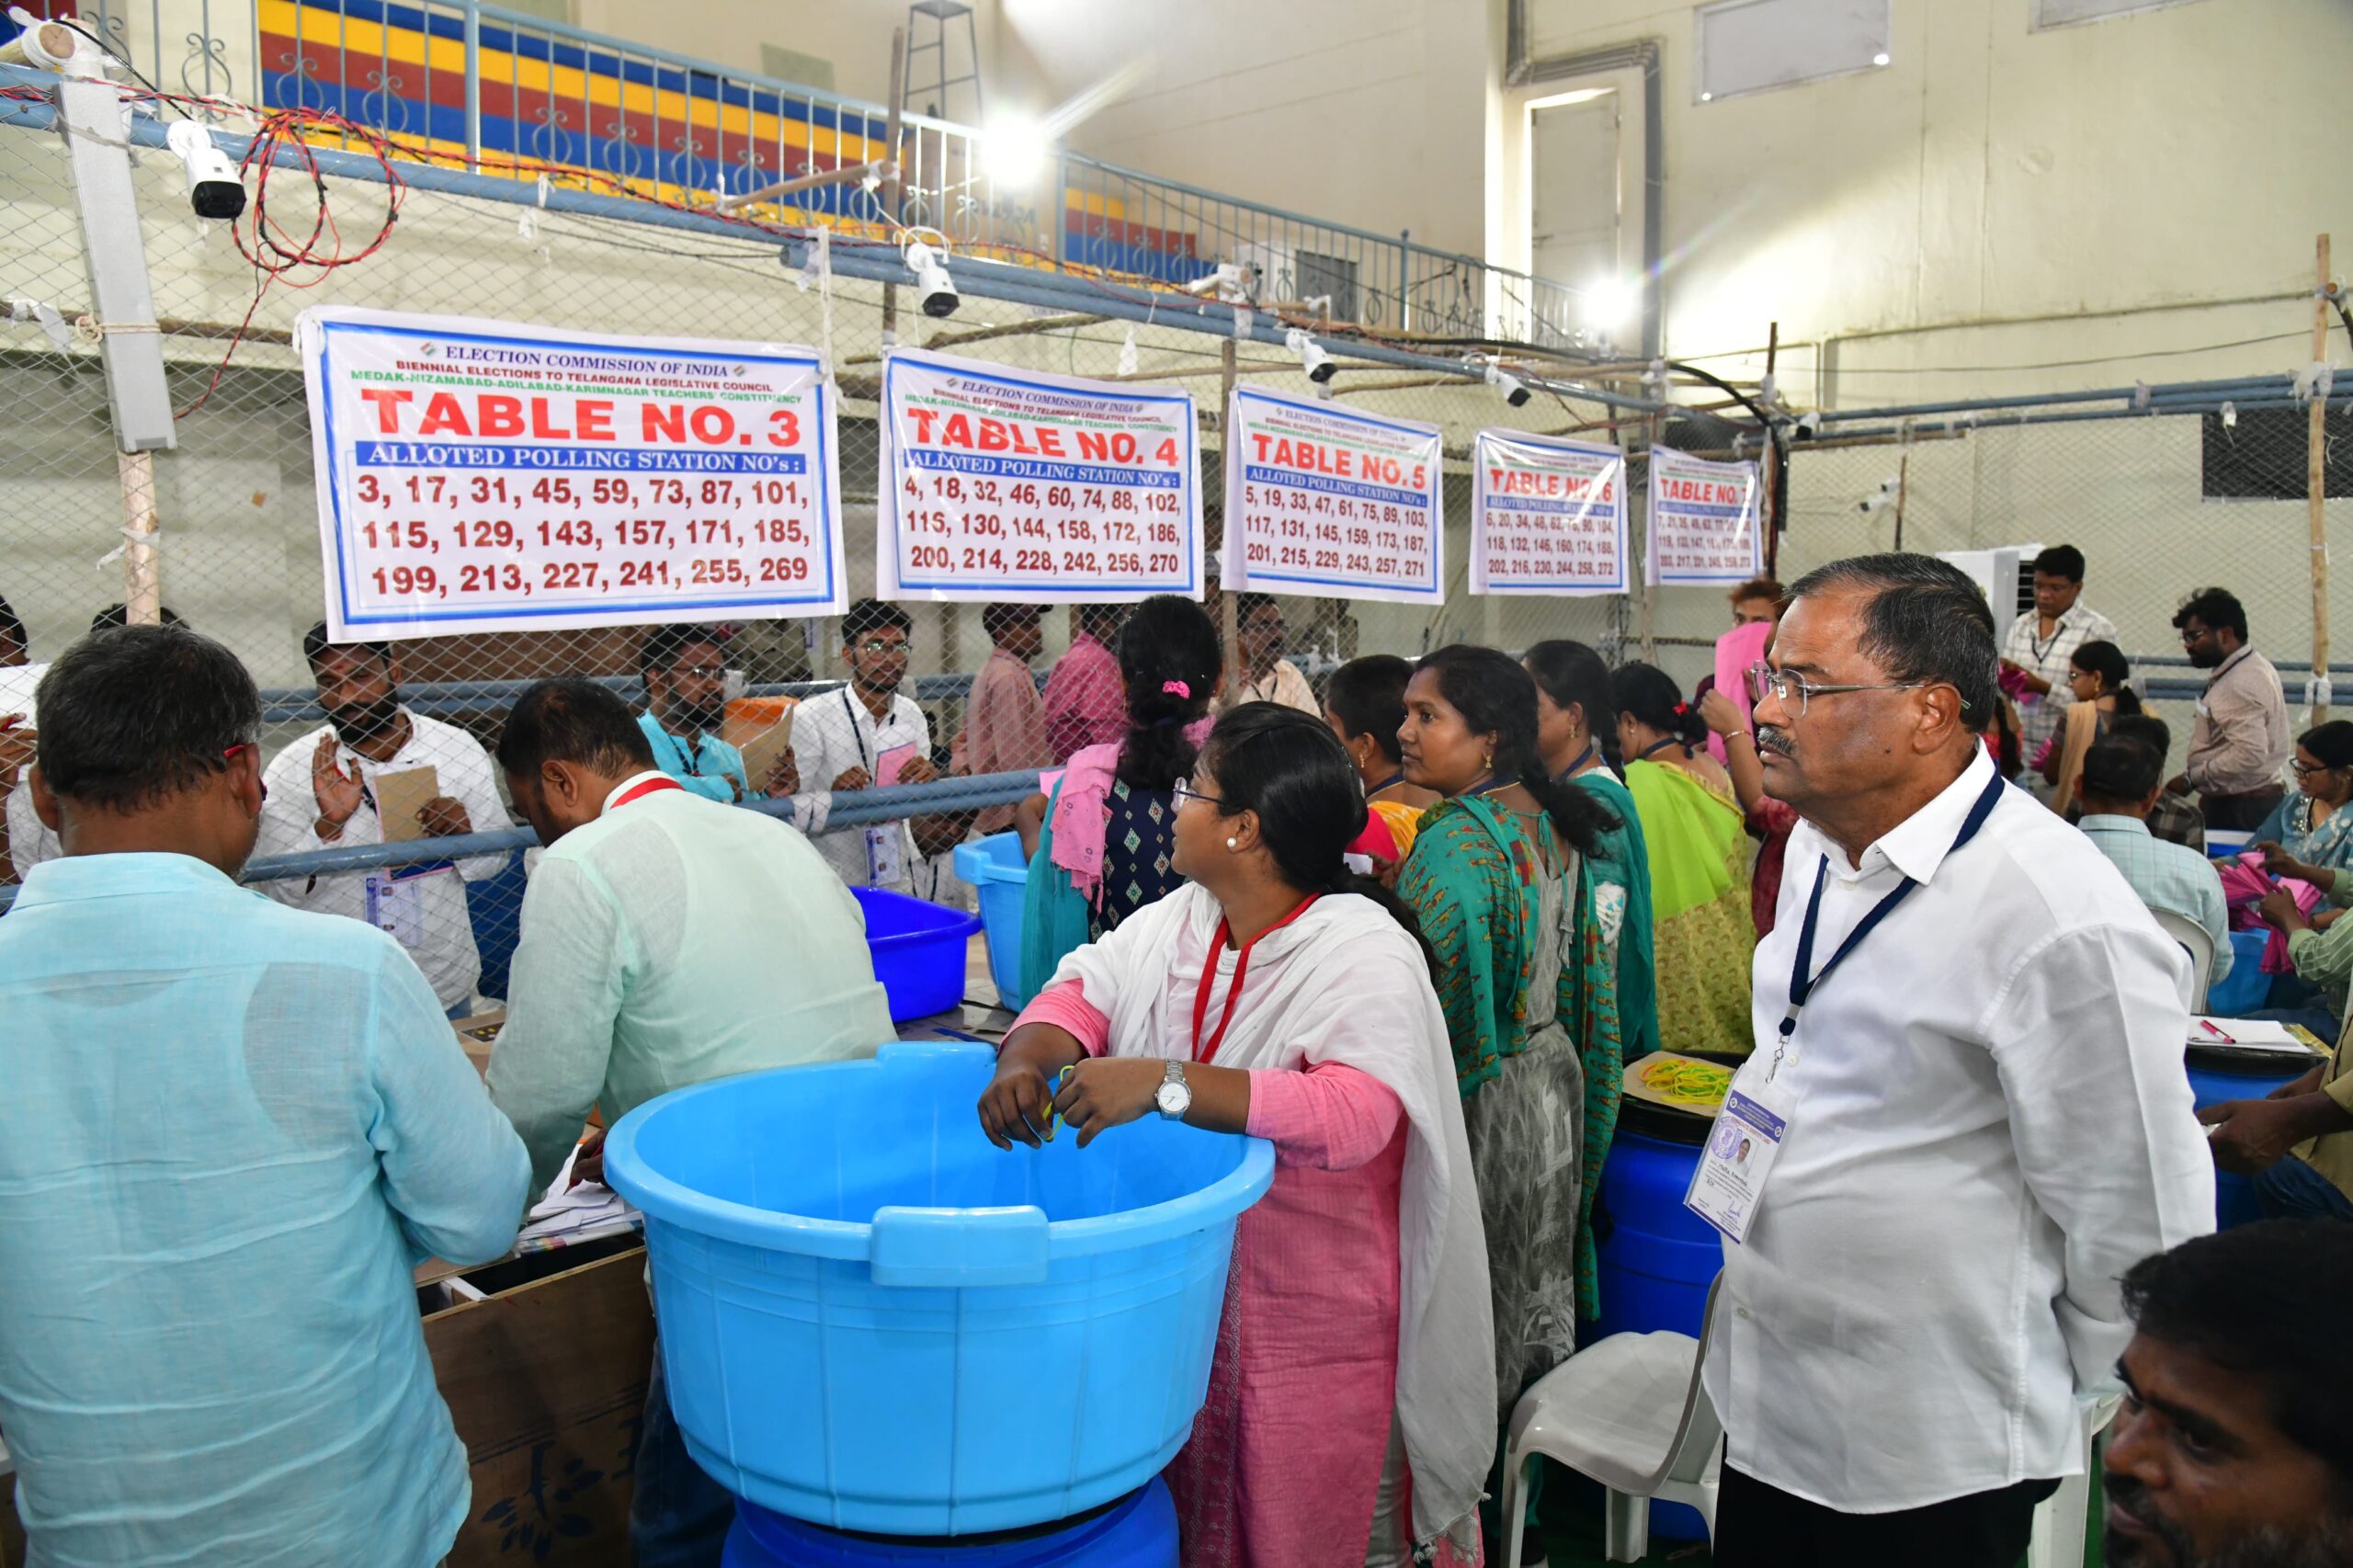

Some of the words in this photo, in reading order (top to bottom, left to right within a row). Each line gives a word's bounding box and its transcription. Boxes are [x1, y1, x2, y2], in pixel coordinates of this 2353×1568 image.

[396, 360, 462, 373] BIENNIAL
[467, 366, 541, 379] ELECTIONS
[546, 371, 563, 381] TO
[567, 372, 642, 385] TELANGANA
[645, 378, 719, 390] LEGISLATIVE
[722, 382, 772, 392] COUNCIL
[447, 347, 540, 364] ELECTION
[546, 355, 656, 372] COMMISSION
[661, 362, 682, 374] OF
[686, 364, 727, 377] INDIA
[962, 381, 1024, 399] ELECTION
[1027, 392, 1092, 409] COMMISSION
[1096, 402, 1107, 410] OF
[1109, 403, 1133, 413] INDIA
[361, 388, 616, 441] TABLE
[642, 403, 752, 446] NO.
[768, 410, 800, 447] 3
[907, 408, 1066, 458] TABLE
[1076, 431, 1143, 464] NO.
[1156, 437, 1178, 467] 4
[369, 446, 504, 464] ALLOTED
[515, 449, 629, 466] POLLING
[639, 453, 736, 469] STATION
[912, 451, 996, 472] ALLOTED
[1001, 460, 1074, 480] POLLING
[1078, 468, 1134, 484] STATION
[1252, 434, 1351, 476] TABLE
[1362, 455, 1408, 487] NO.
[1413, 465, 1426, 490] 5
[358, 474, 391, 508] 3,
[406, 475, 459, 509] 17,
[471, 476, 522, 508] 31,
[533, 477, 581, 508] 45,
[594, 479, 639, 507] 59,
[650, 479, 691, 507] 73,
[702, 480, 741, 507] 87,
[753, 482, 808, 507] 101,
[905, 475, 923, 500] 4,
[934, 476, 968, 502] 18,
[974, 480, 1004, 504] 32,
[1009, 484, 1040, 508] 46,
[1047, 486, 1075, 510] 60,
[1083, 488, 1108, 512] 74,
[1111, 491, 1139, 513] 88,
[1146, 493, 1180, 515] 102,
[1251, 468, 1305, 486] ALLOTED
[1308, 477, 1355, 494] POLLING
[1358, 484, 1400, 501] STATION
[1490, 469, 1559, 496] TABLE
[1603, 482, 1612, 502] 6
[1661, 478, 1712, 501] TABLE
[1245, 486, 1258, 506] 5,
[1265, 488, 1285, 510] 19,
[1290, 493, 1310, 513] 33,
[1315, 497, 1335, 517] 47,
[1339, 500, 1358, 520] 61,
[1362, 504, 1380, 522] 75,
[1383, 507, 1401, 526] 89,
[1405, 511, 1427, 529] 103,
[362, 520, 439, 553] 115,
[453, 520, 524, 551] 129,
[538, 520, 603, 550] 143,
[616, 519, 675, 548] 157,
[688, 520, 745, 546] 171,
[756, 519, 809, 546] 185,
[907, 510, 952, 538] 116,
[961, 514, 1006, 540] 130,
[1013, 517, 1051, 541] 144,
[1058, 520, 1097, 544] 158,
[1102, 521, 1142, 545] 172,
[1148, 522, 1180, 546] 186,
[1246, 515, 1275, 537] 117,
[1281, 519, 1310, 540] 131,
[1315, 524, 1342, 545] 145,
[1347, 528, 1371, 548] 159,
[1377, 533, 1400, 551] 173,
[1404, 536, 1427, 555] 187,
[912, 545, 956, 572] 200,
[962, 547, 1008, 574] 214,
[1016, 549, 1058, 575] 228,
[1063, 551, 1102, 575] 242,
[1108, 552, 1144, 576] 256,
[1149, 553, 1178, 573] 270
[1248, 544, 1276, 565] 201,
[1281, 548, 1310, 568] 215,
[1315, 551, 1343, 572] 229,
[1347, 555, 1371, 574] 243,
[1377, 559, 1401, 577] 257,
[1405, 562, 1425, 576] 271
[373, 565, 447, 597] 199,
[461, 564, 532, 596] 213,
[544, 562, 609, 592] 227,
[620, 561, 681, 586] 241,
[693, 559, 750, 585] 255,
[761, 558, 808, 581] 269
